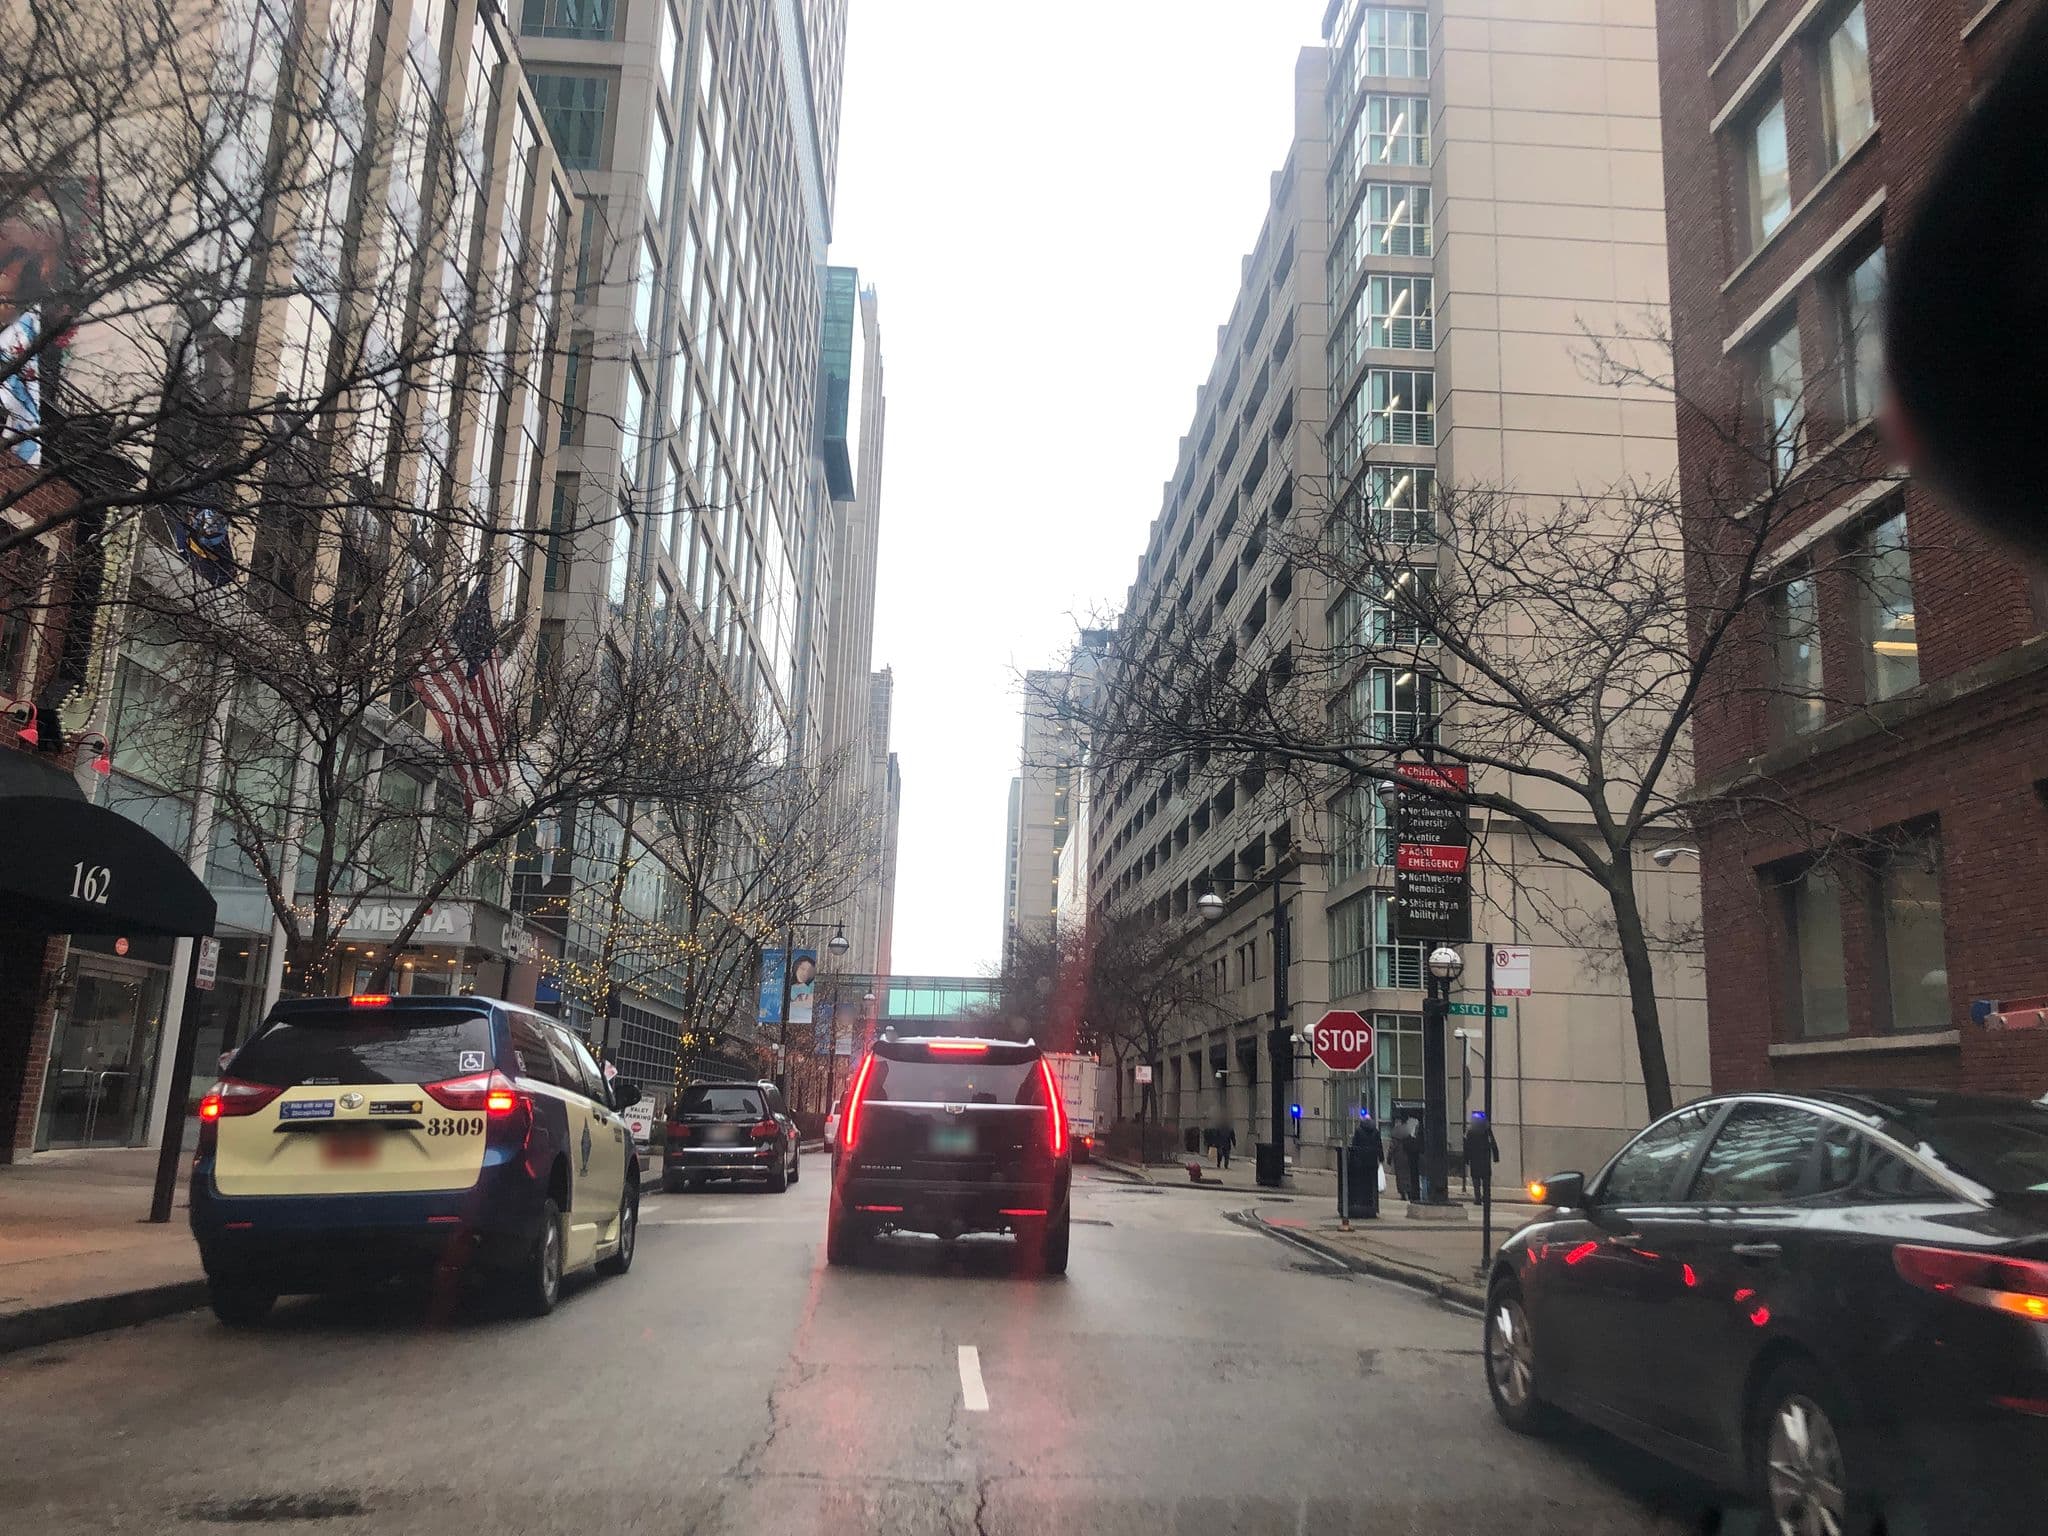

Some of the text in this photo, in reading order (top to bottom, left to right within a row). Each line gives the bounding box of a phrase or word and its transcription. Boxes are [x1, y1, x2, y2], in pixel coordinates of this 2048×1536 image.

[1407, 766, 1453, 778] Childr's
[1407, 807, 1461, 818] Nothwesten
[1408, 858, 1460, 869] EMERGENCY
[70, 861, 111, 905] 162
[312, 904, 455, 934] MBIA
[1460, 1004, 1469, 1014] ST
[1471, 1005, 1497, 1015] CLR
[1317, 1029, 1369, 1053] STOP
[630, 1106, 649, 1114] VALET
[625, 1113, 651, 1121] PARKING
[427, 1117, 484, 1137] 3309
